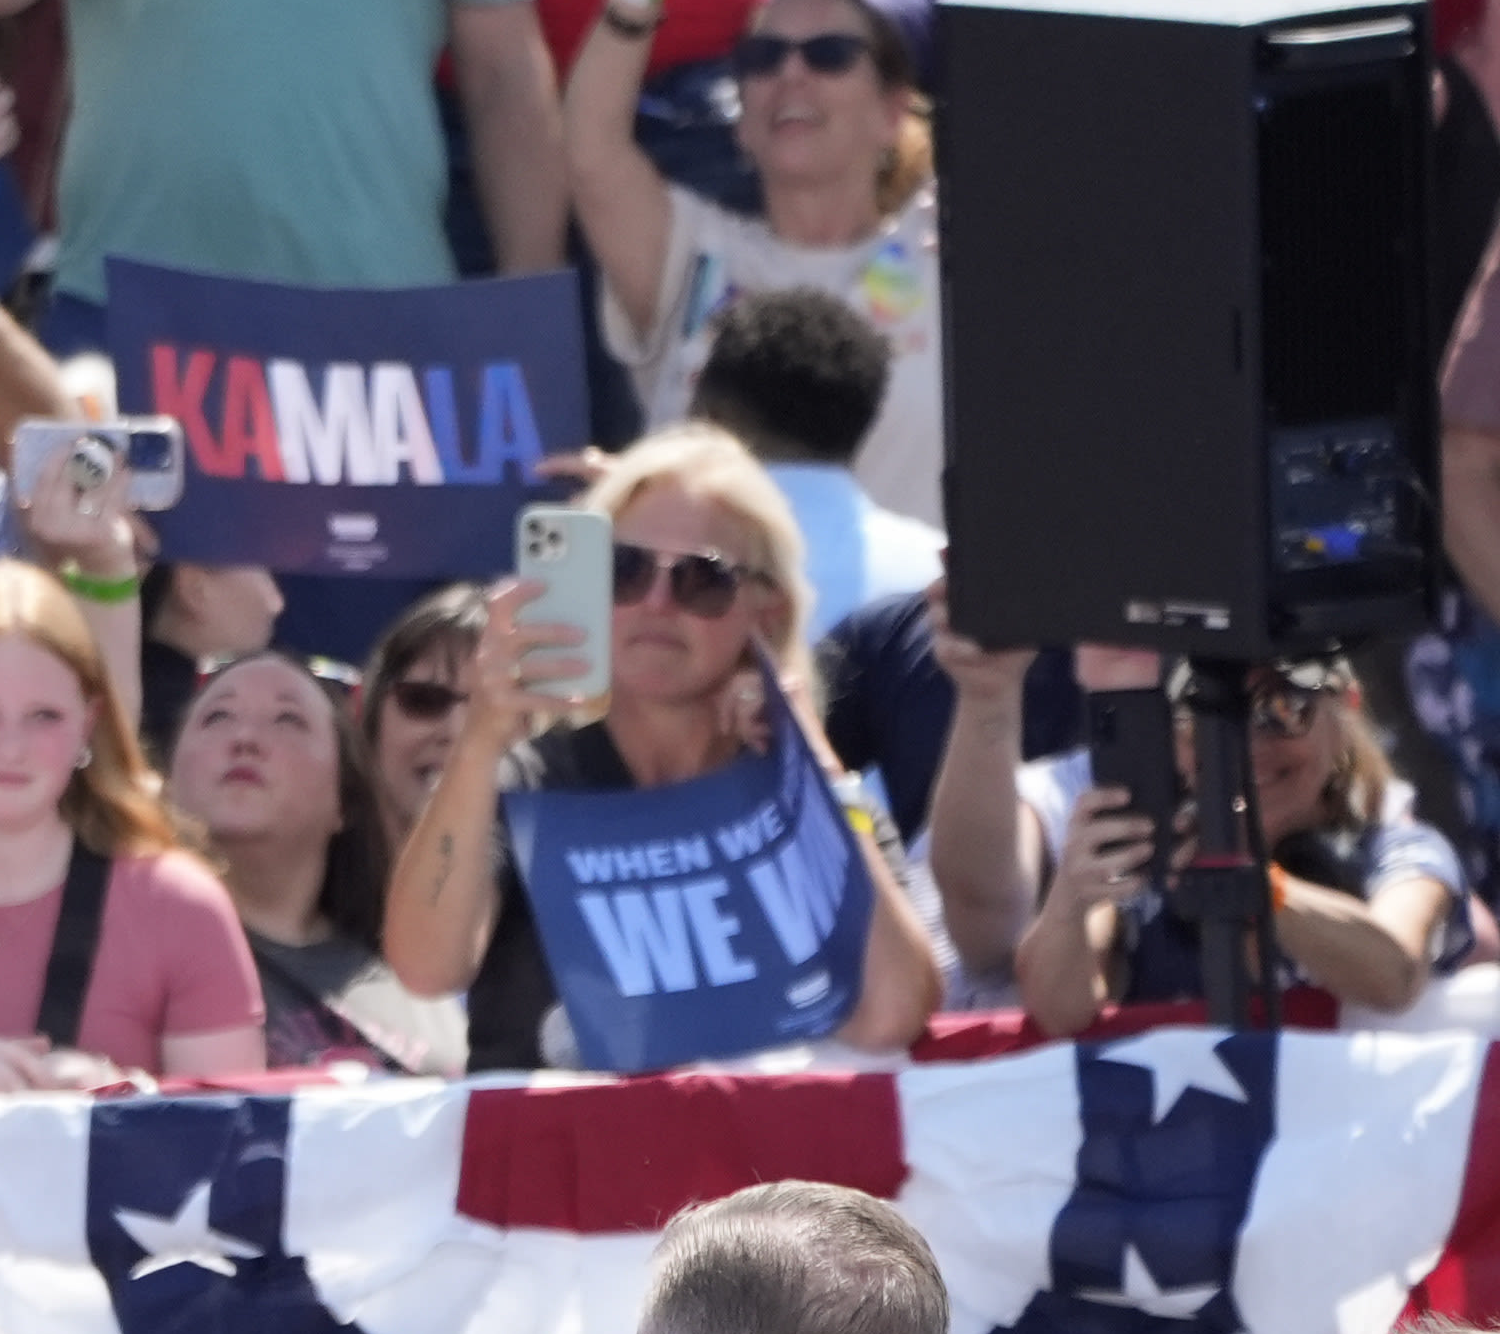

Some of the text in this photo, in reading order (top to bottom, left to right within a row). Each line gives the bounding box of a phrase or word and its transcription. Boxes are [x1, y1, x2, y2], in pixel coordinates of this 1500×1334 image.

[150, 344, 550, 487] KAMALA
[565, 802, 788, 885] WHEN WE
[576, 876, 758, 998] WE
